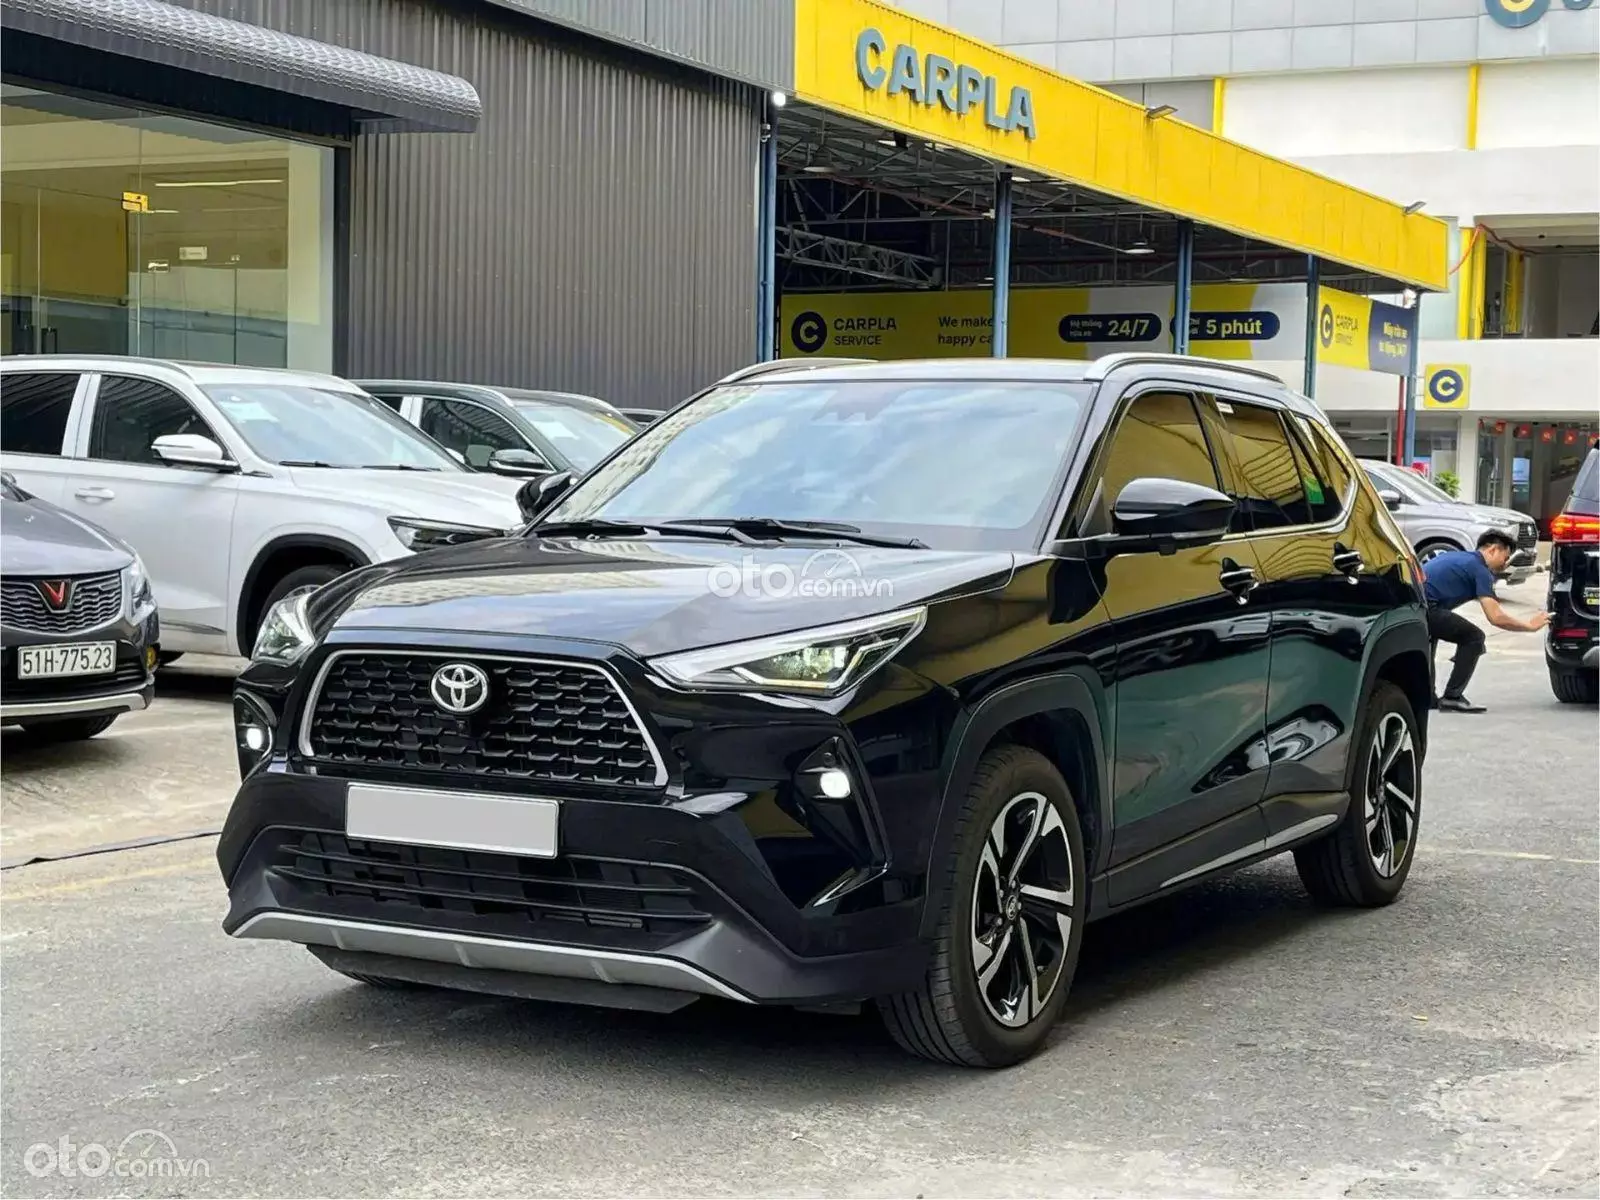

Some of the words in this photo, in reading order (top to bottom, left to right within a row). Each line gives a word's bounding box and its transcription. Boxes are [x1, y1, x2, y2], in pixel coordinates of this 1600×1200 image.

[856, 28, 1036, 140] CARPLA
[834, 317, 897, 331] CARPLA
[938, 316, 959, 328] We
[1107, 319, 1150, 338] 24/7
[1206, 319, 1217, 334] 5
[1221, 318, 1263, 339] phút
[834, 335, 882, 346] SERVICE
[938, 333, 976, 347] happy
[23, 647, 112, 674] 51H-775.23
